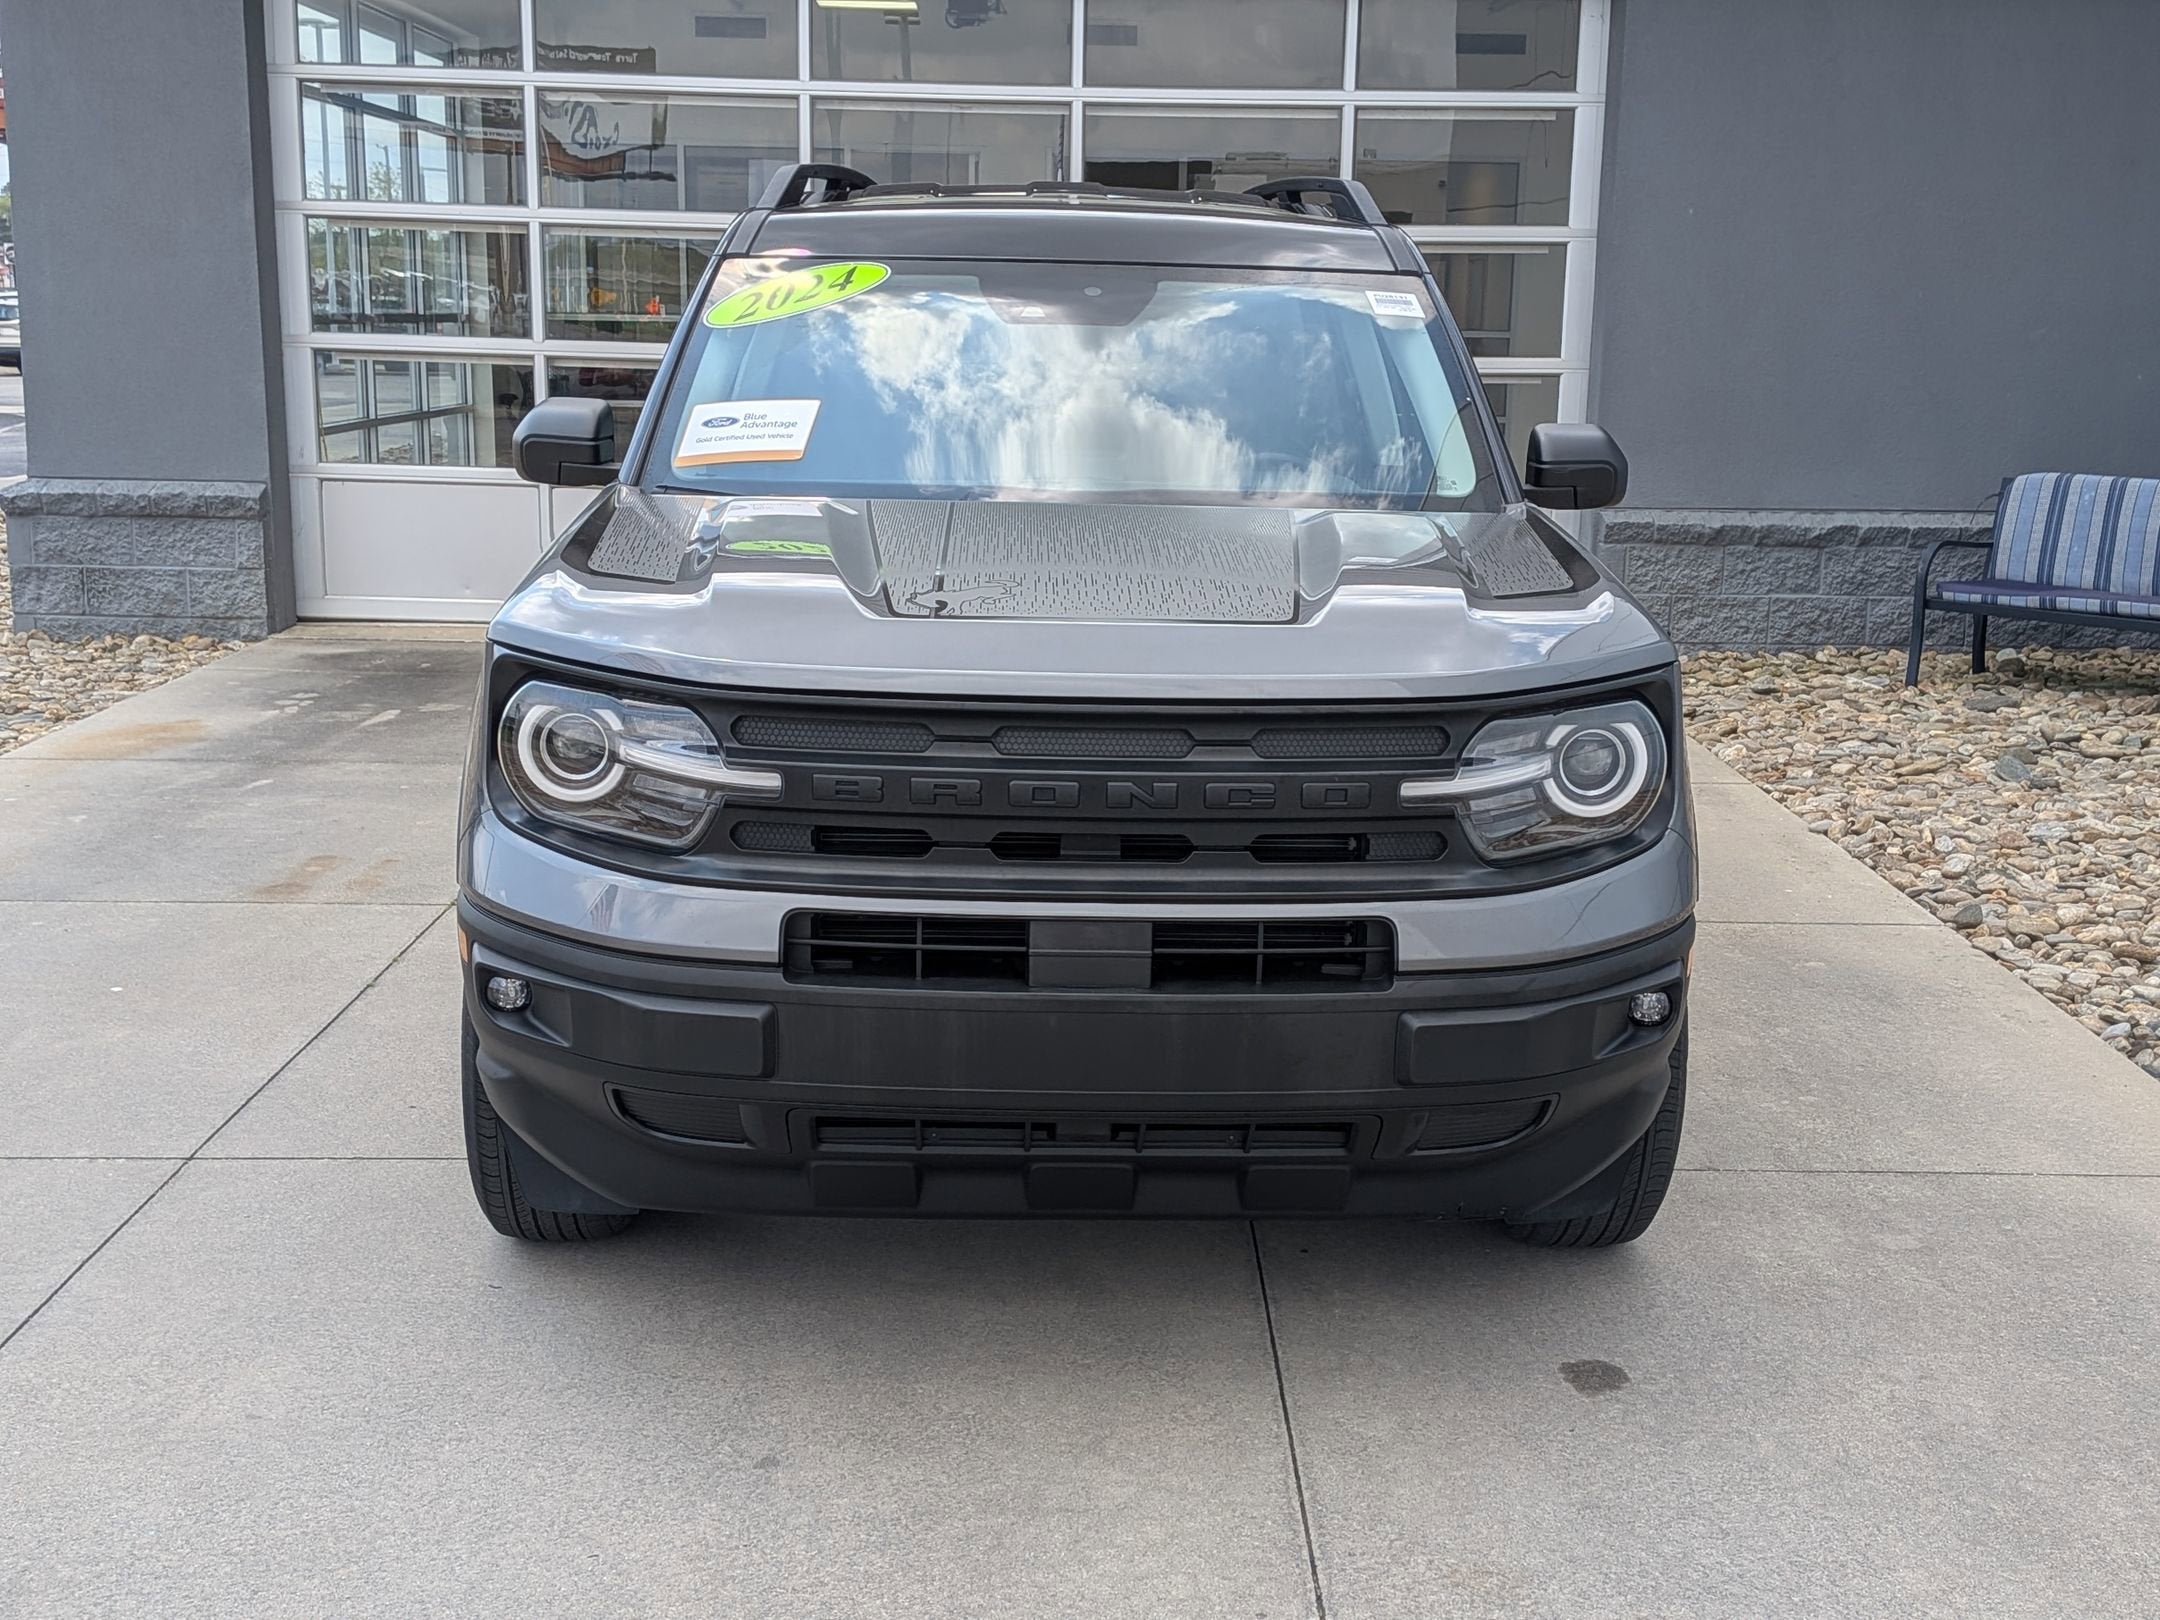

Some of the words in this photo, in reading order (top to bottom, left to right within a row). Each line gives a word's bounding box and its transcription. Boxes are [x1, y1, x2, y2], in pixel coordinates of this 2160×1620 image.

[733, 265, 858, 322] 2024
[743, 412, 768, 421] Blue
[740, 420, 798, 429] Advantage
[695, 436, 713, 444] Gold
[713, 433, 745, 442] Certified
[811, 773, 1372, 809] BRONCO
